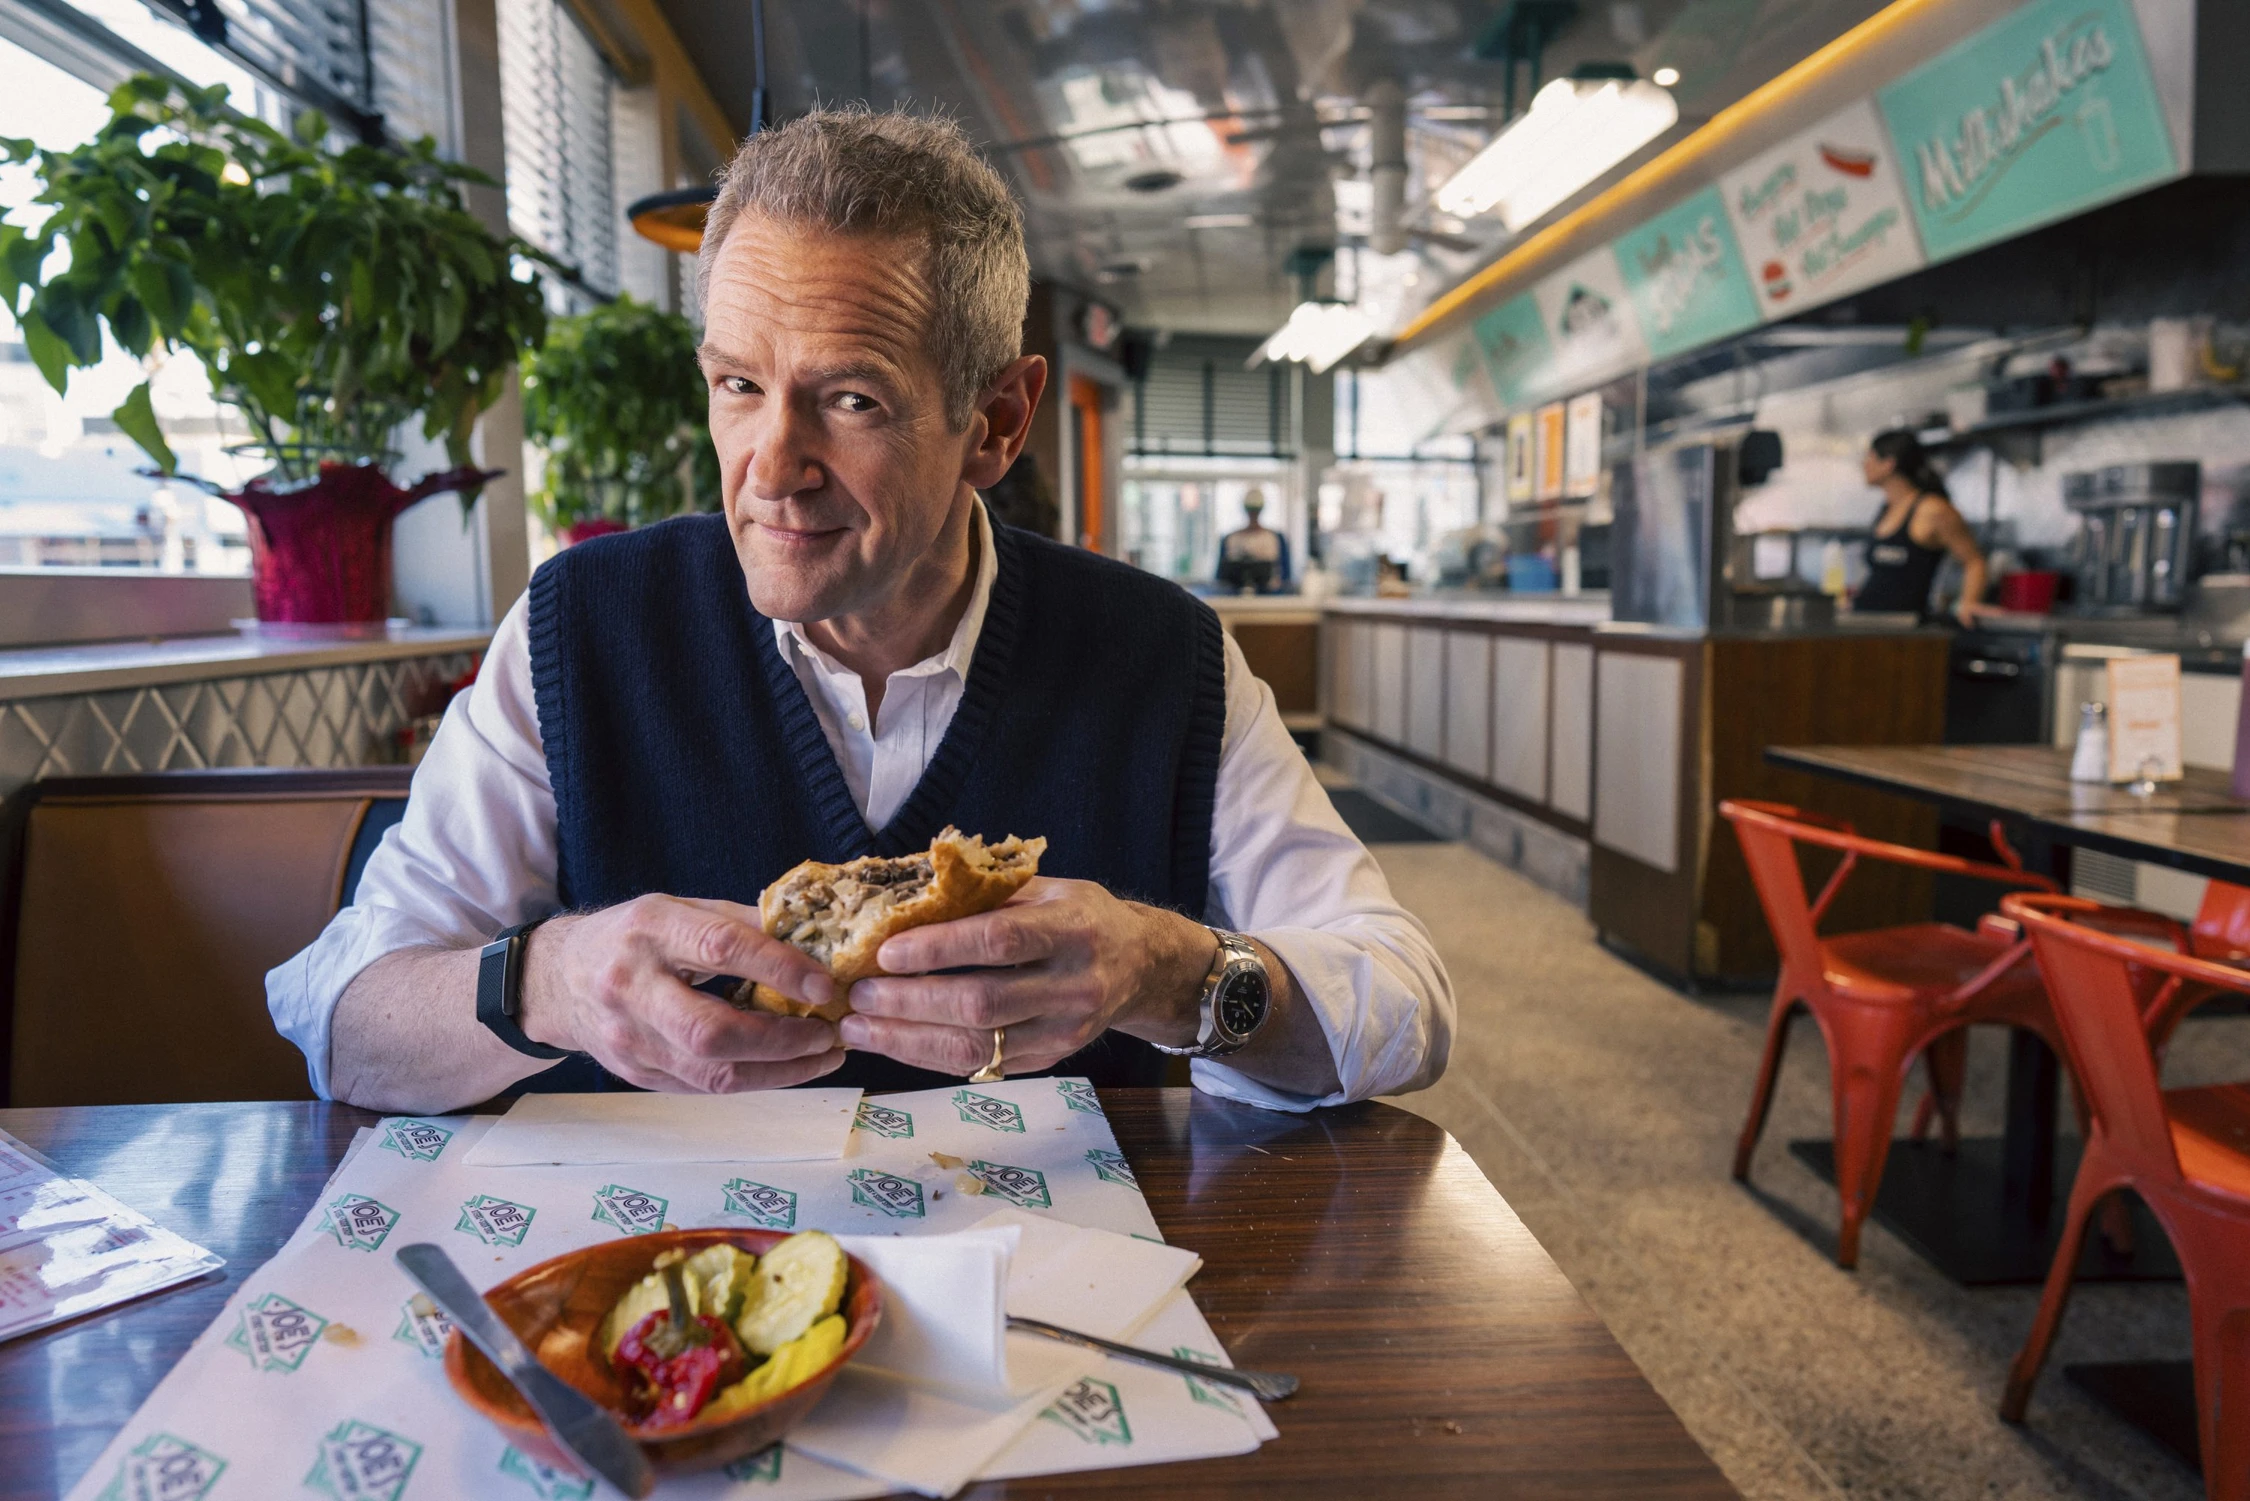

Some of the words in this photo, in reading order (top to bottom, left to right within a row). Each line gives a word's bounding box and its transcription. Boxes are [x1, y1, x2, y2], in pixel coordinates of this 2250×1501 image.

[1915, 25, 2115, 212] Milkshakes
[860, 1108, 912, 1129] JOE'S
[969, 1098, 1022, 1124] JOE'S
[402, 1125, 446, 1150] JOE'S
[865, 1175, 923, 1207] JOE'S
[986, 1166, 1046, 1195] JOE'S
[612, 1192, 664, 1223] JOE'S
[740, 1186, 796, 1214] JOE'S
[342, 1200, 390, 1236] JOE'S
[480, 1202, 530, 1232] JOE'S
[1063, 1381, 1121, 1422] OE'S
